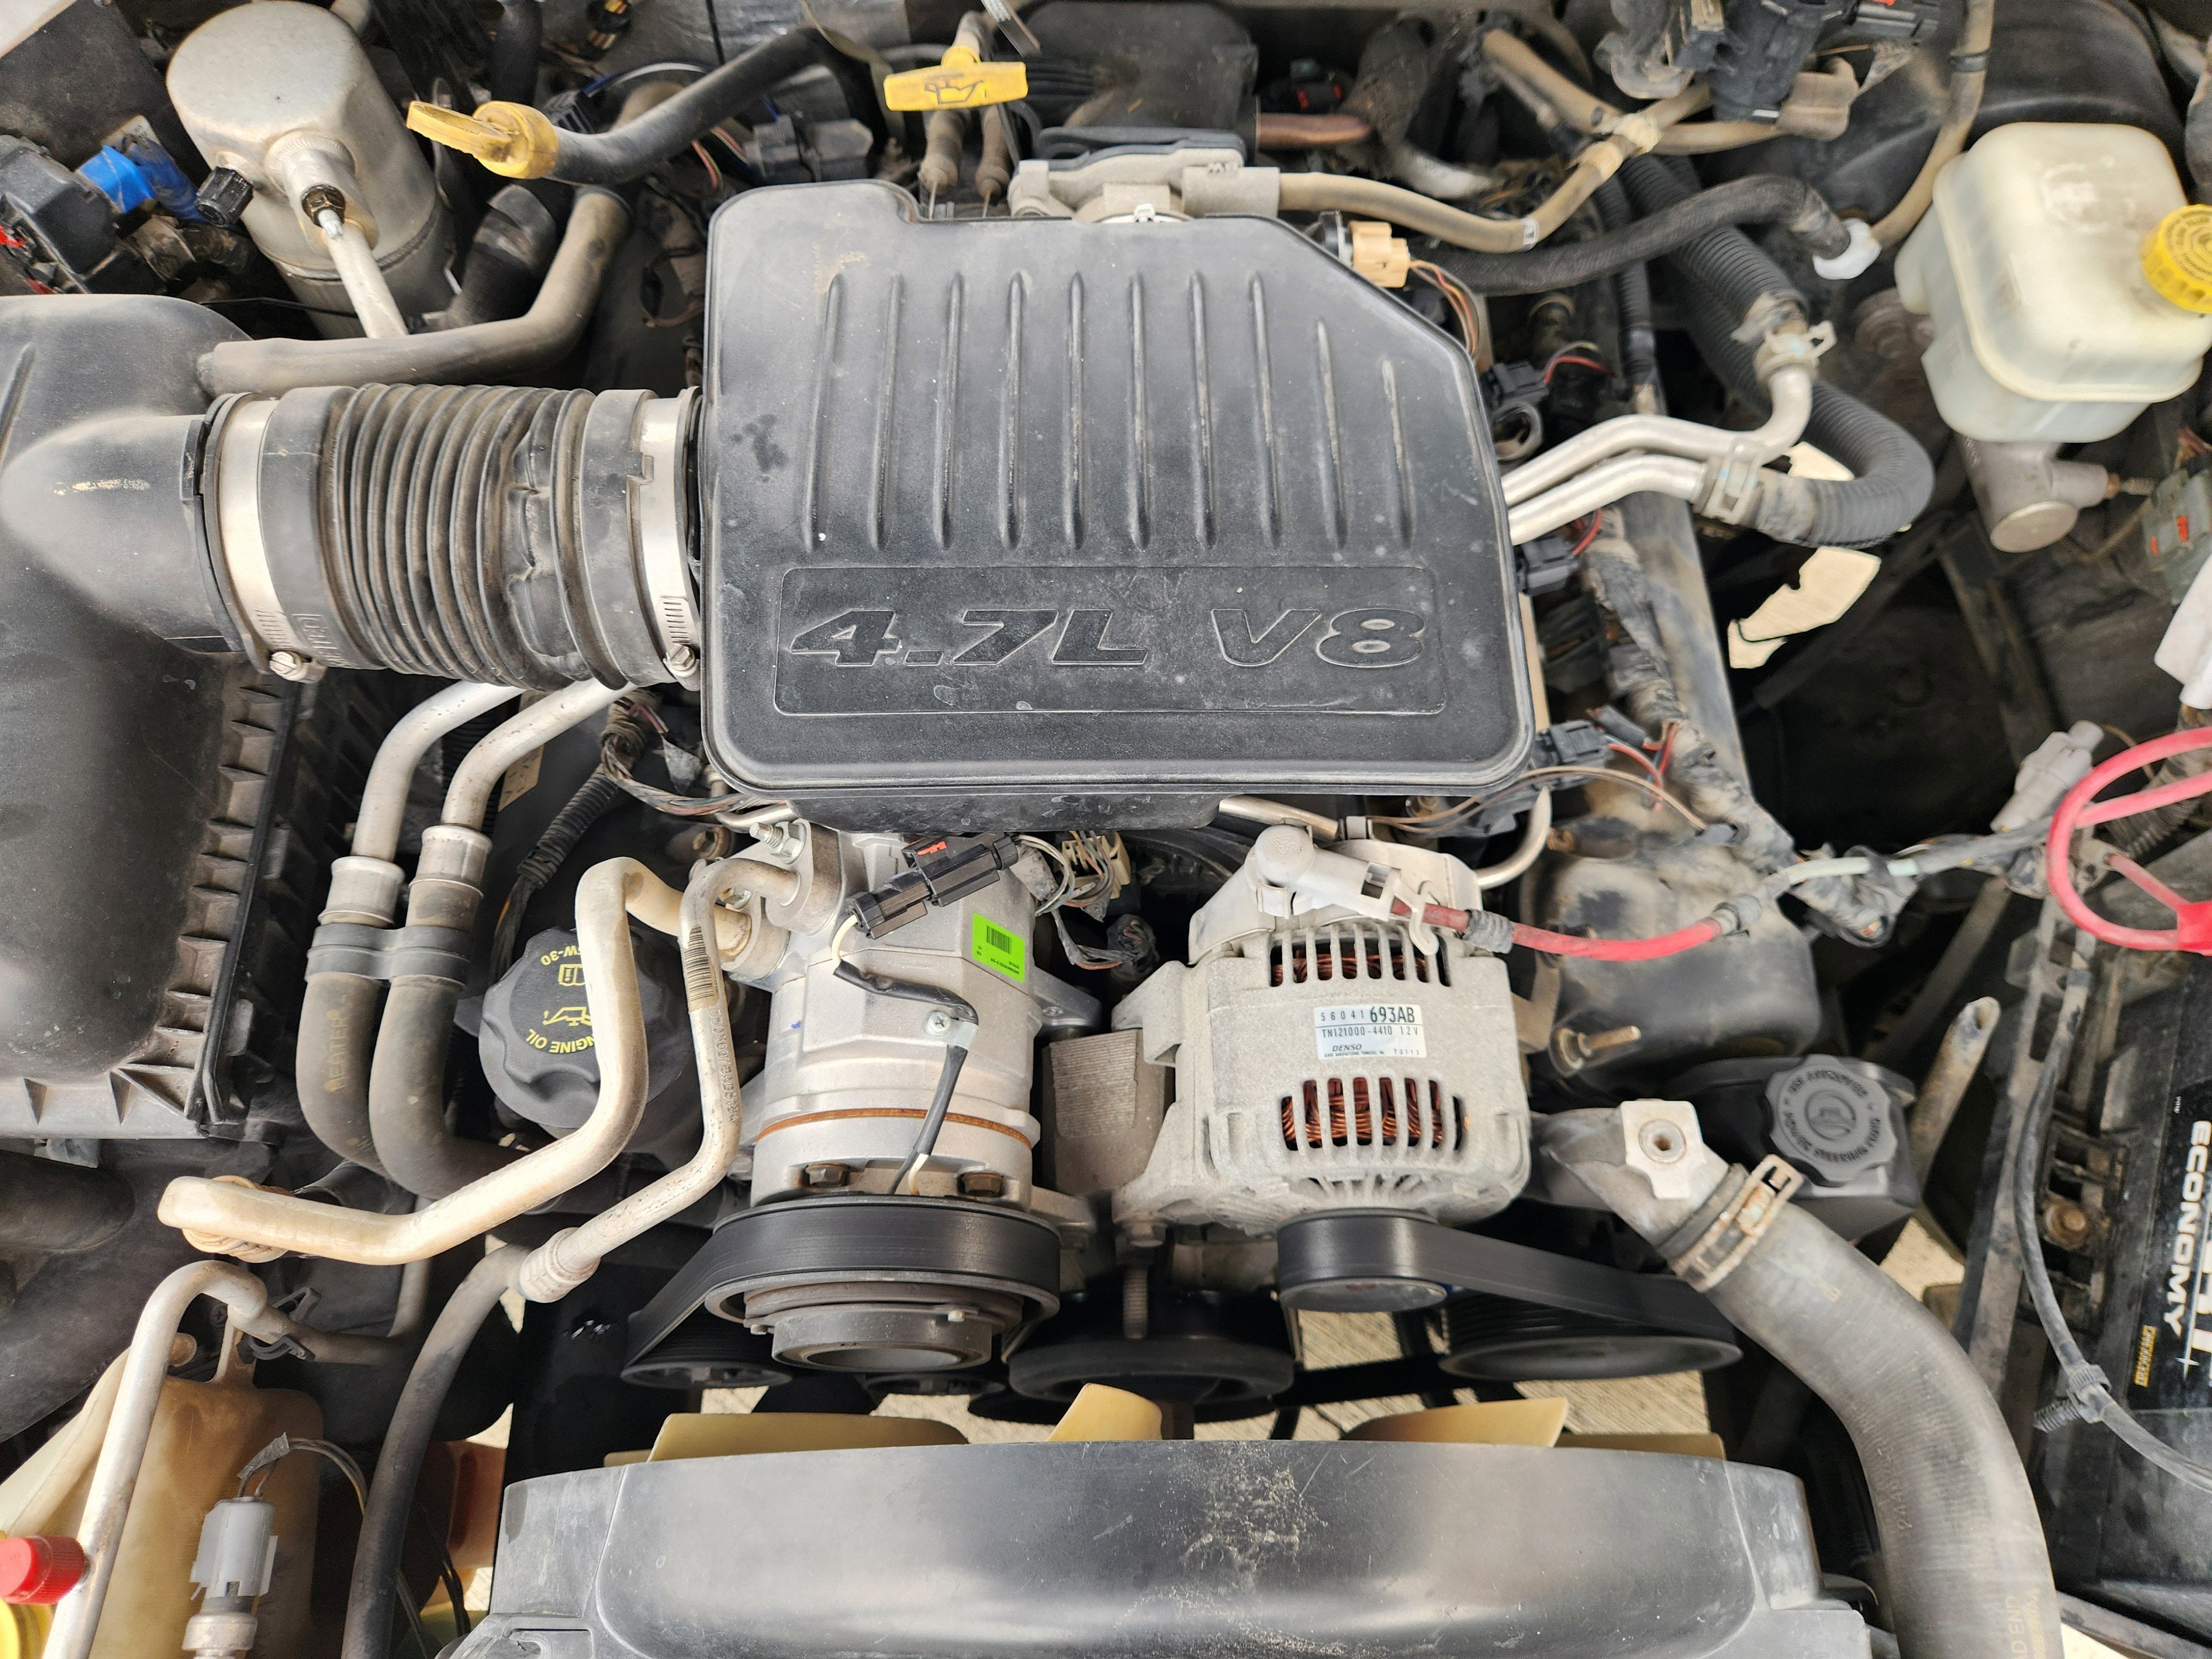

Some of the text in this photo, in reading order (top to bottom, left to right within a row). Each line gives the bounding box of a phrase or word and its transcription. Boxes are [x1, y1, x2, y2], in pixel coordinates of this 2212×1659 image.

[790, 607, 1426, 669] 4.7L V8
[525, 1028, 594, 1053] NGINE OIL
[1322, 1025, 1418, 1038] TN121000-4410 12V
[1332, 1043, 1363, 1051] DENSO
[2163, 1120, 2211, 1339] ECONOMY
